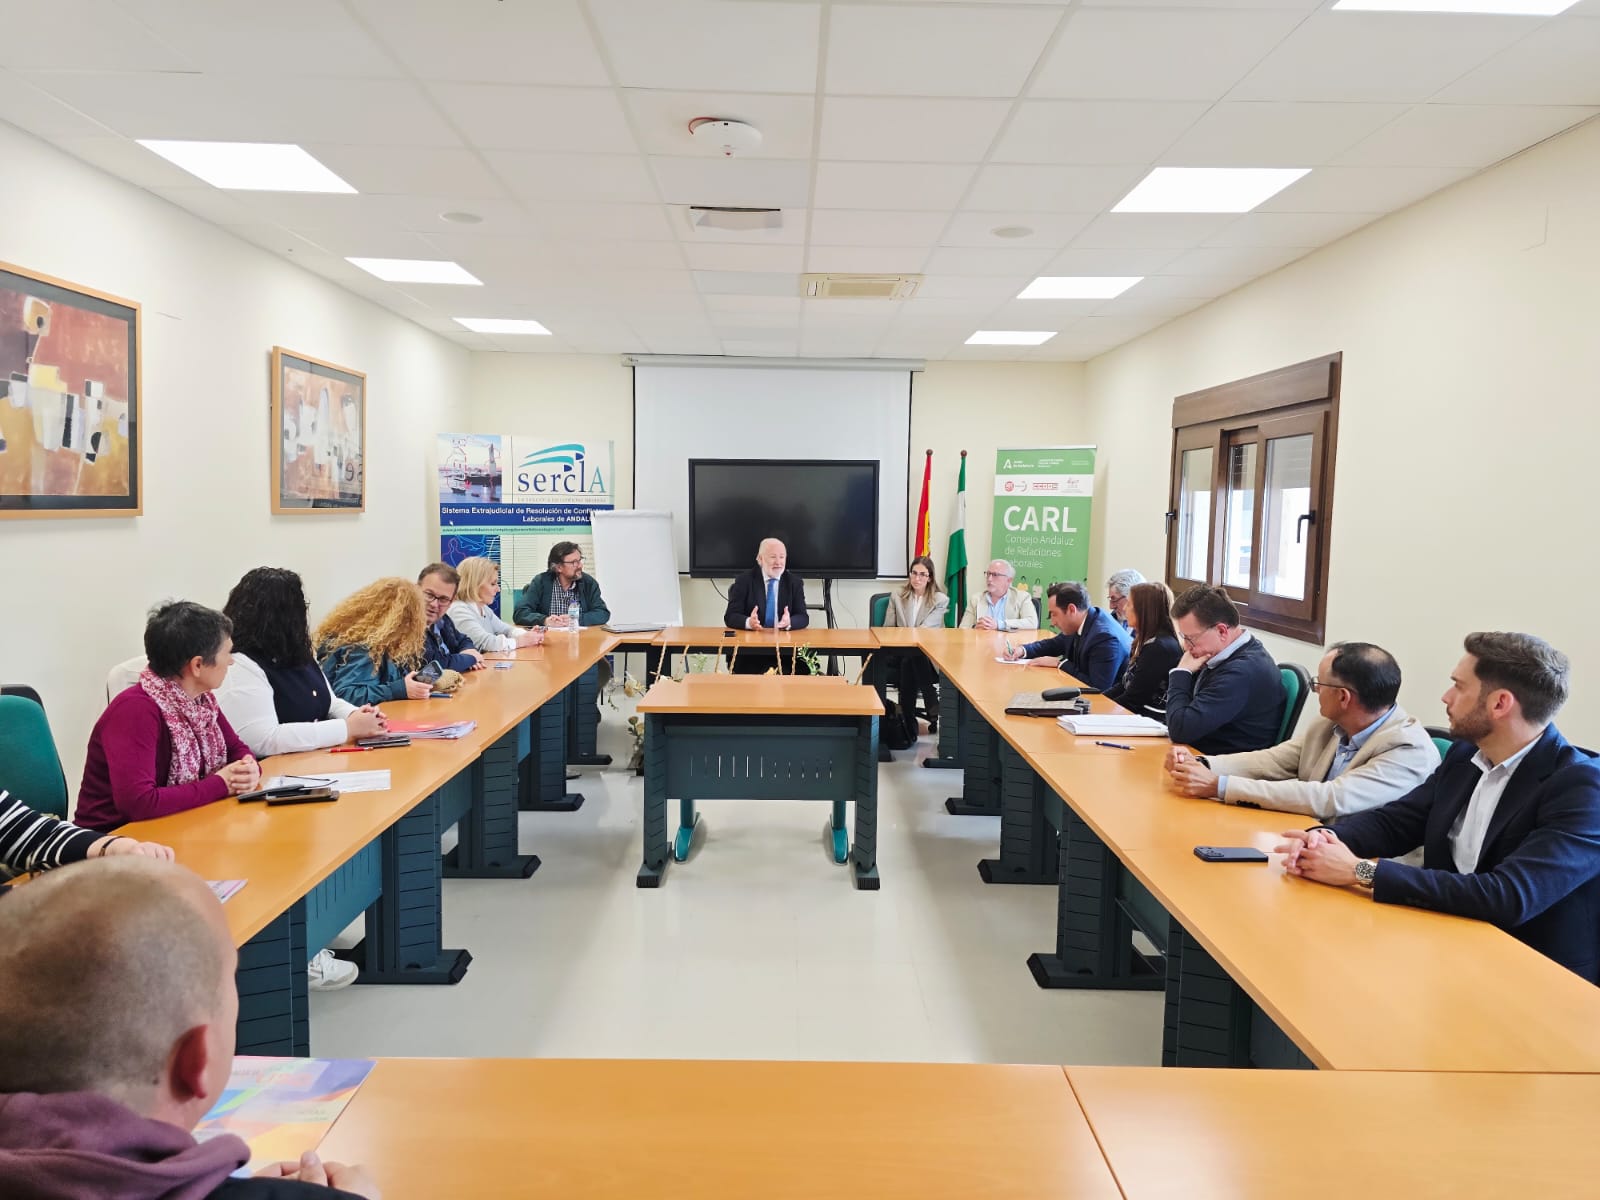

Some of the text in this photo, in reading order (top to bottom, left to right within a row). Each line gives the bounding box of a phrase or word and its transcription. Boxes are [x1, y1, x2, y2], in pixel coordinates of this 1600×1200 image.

[471, 507, 514, 515] Extrajudicial
[1003, 505, 1077, 533] CARL
[1005, 534, 1074, 546] Consejo Andaluz
[1005, 546, 1062, 557] de Relaciones
[1007, 558, 1044, 569] aborales
